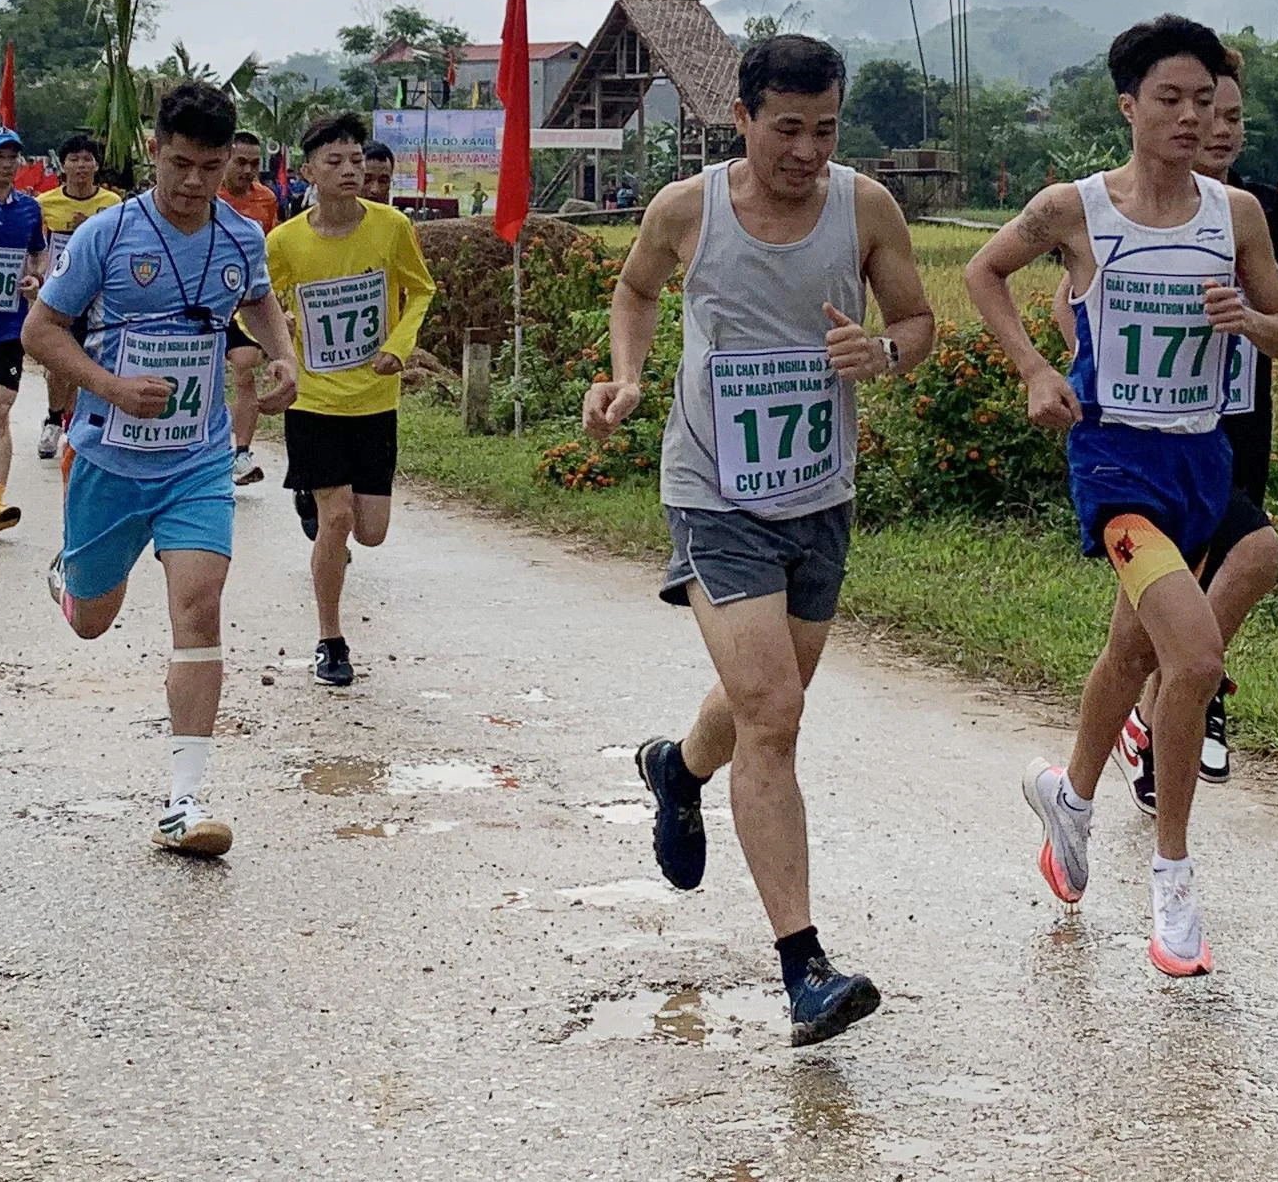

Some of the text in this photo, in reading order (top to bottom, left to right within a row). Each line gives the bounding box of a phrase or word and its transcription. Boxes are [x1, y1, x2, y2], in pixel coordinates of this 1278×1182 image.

[1109, 297, 1132, 313] HALF
[1133, 300, 1184, 316] MARATHON
[317, 305, 379, 346] 173
[337, 348, 352, 360] LY
[1118, 323, 1214, 379] 177
[714, 359, 734, 378] GIẢI
[735, 363, 761, 380] CHẠY
[762, 359, 776, 378] BỘ
[720, 383, 743, 398] HALF
[745, 379, 798, 397] MARATHON
[1112, 383, 1139, 406] CỰ
[1142, 385, 1163, 405] LY
[1170, 384, 1209, 405] 10KM
[122, 423, 198, 443] CỰ LY 10KM
[733, 398, 833, 463] 178
[735, 454, 833, 495] CỰ LY 10KM
